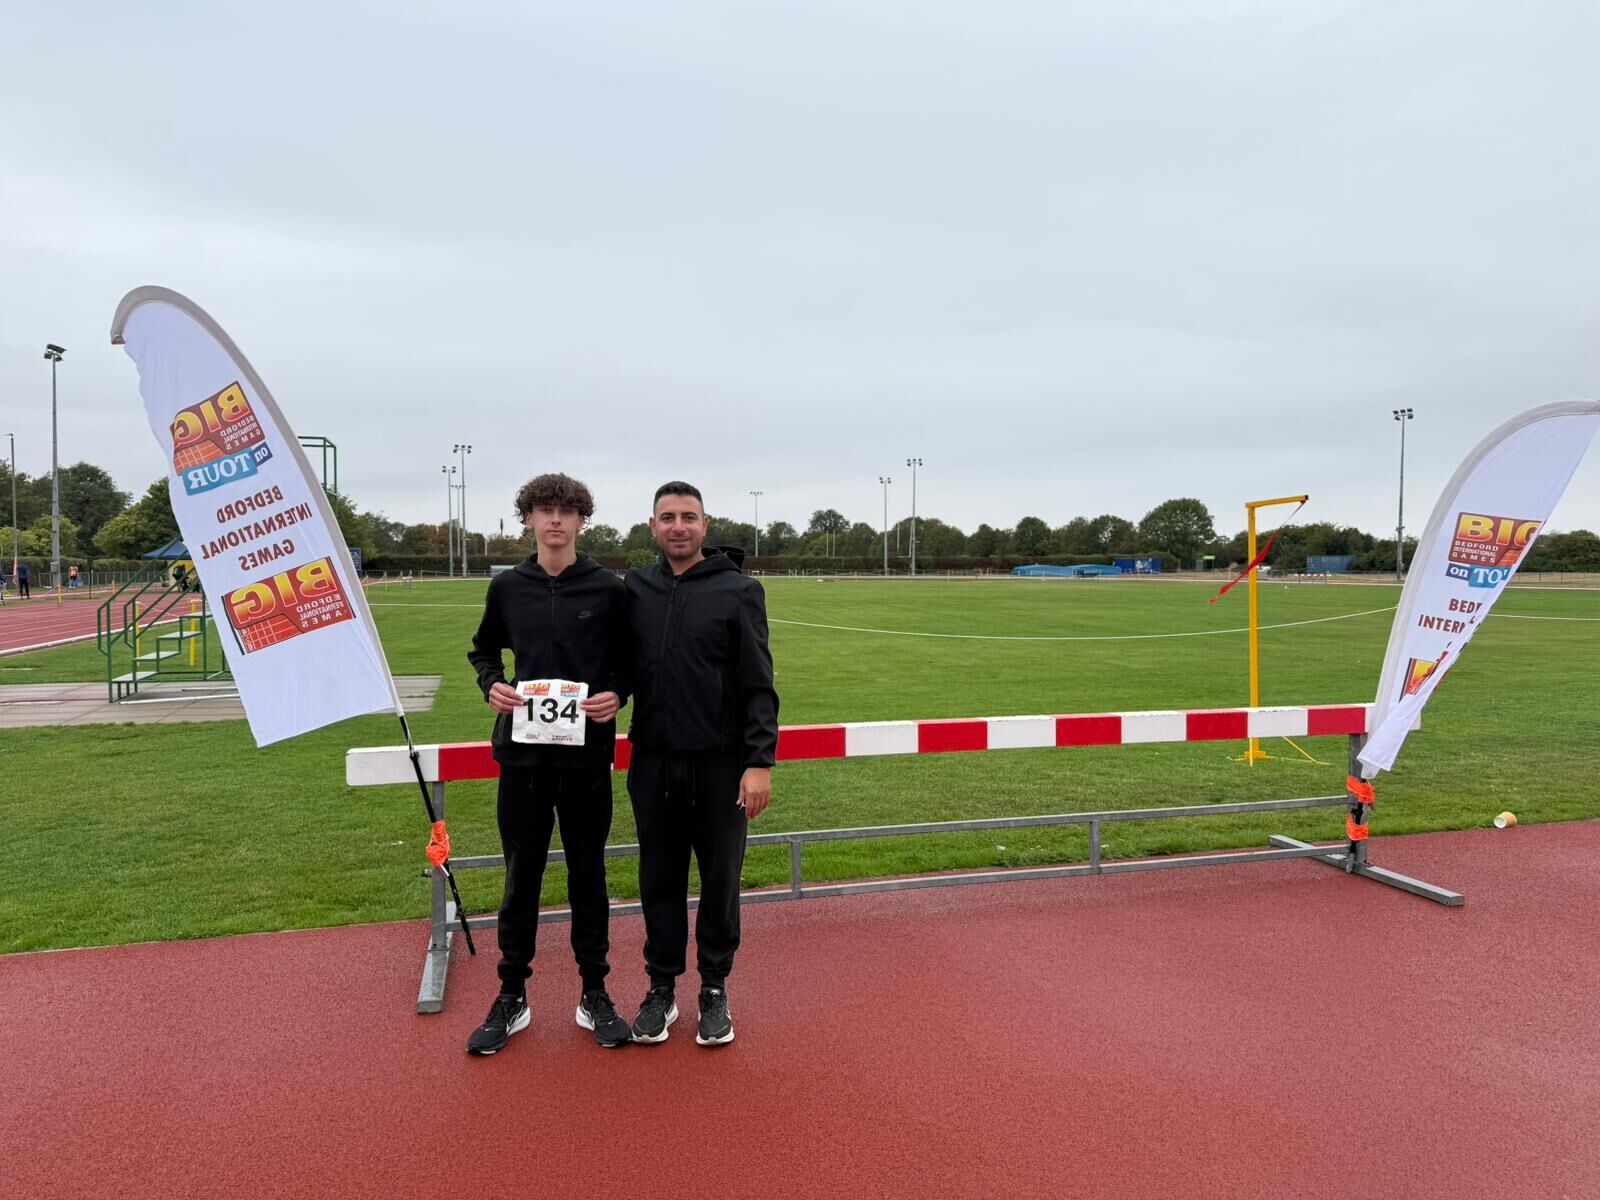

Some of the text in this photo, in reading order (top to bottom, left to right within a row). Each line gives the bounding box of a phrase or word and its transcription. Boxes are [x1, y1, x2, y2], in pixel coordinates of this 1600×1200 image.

[1455, 540, 1499, 551] BEDFORD
[1452, 551, 1496, 563] GAMES
[1453, 546, 1497, 558] INTERNATIONAL
[1450, 566, 1507, 584] on TO
[523, 698, 579, 724] 134
